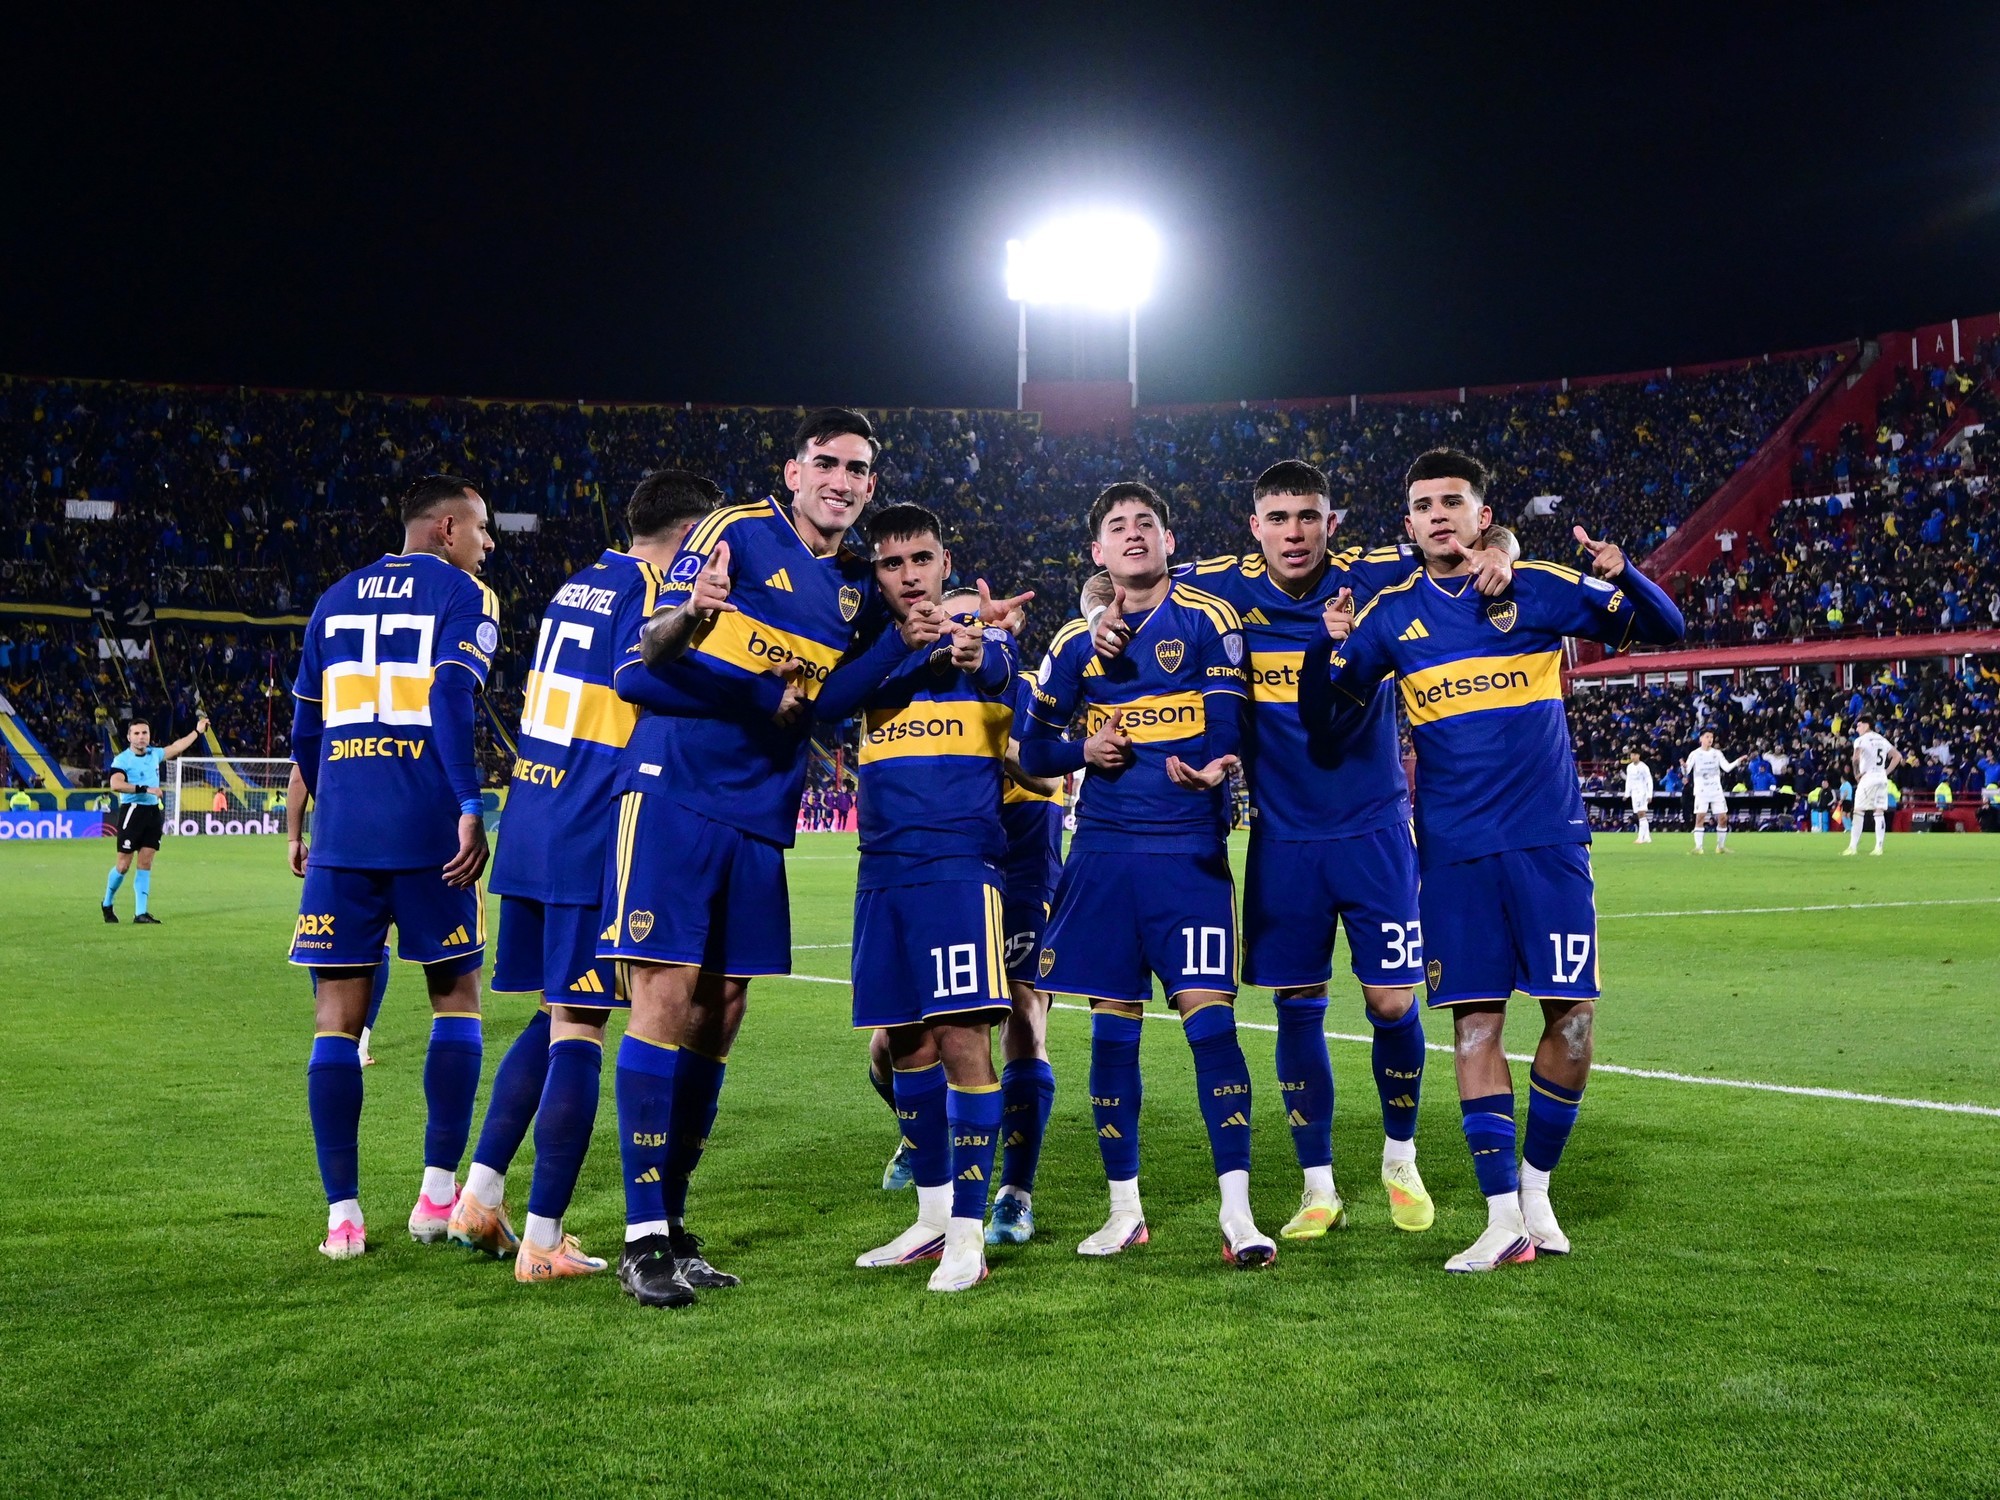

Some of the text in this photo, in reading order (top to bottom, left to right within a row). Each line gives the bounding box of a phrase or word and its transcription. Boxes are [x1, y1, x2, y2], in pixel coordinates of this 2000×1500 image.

[1935, 334, 1945, 354] A
[357, 576, 414, 599] VILLA
[840, 597, 857, 607] CABJ
[1491, 610, 1514, 620] CABJ
[1158, 650, 1181, 659] CABJ
[324, 613, 436, 729] 22
[520, 618, 595, 747] 16
[1414, 670, 1529, 708] betsson
[868, 718, 964, 745] etsson
[327, 737, 425, 761] DIRECTV
[1875, 748, 1884, 767] 5
[205, 813, 279, 834] bank
[631, 921, 650, 929] CABJ
[1181, 926, 1226, 975] 10
[1381, 920, 1422, 969] 32
[1550, 933, 1590, 983] 19
[930, 943, 978, 998] 18
[1385, 1067, 1421, 1079] CABJ
[1213, 1084, 1248, 1097] CABJ
[1279, 1081, 1306, 1091] ABJ
[896, 1108, 918, 1120] ABJ
[633, 1132, 667, 1147] CABJ
[954, 1135, 990, 1147] CABJ
